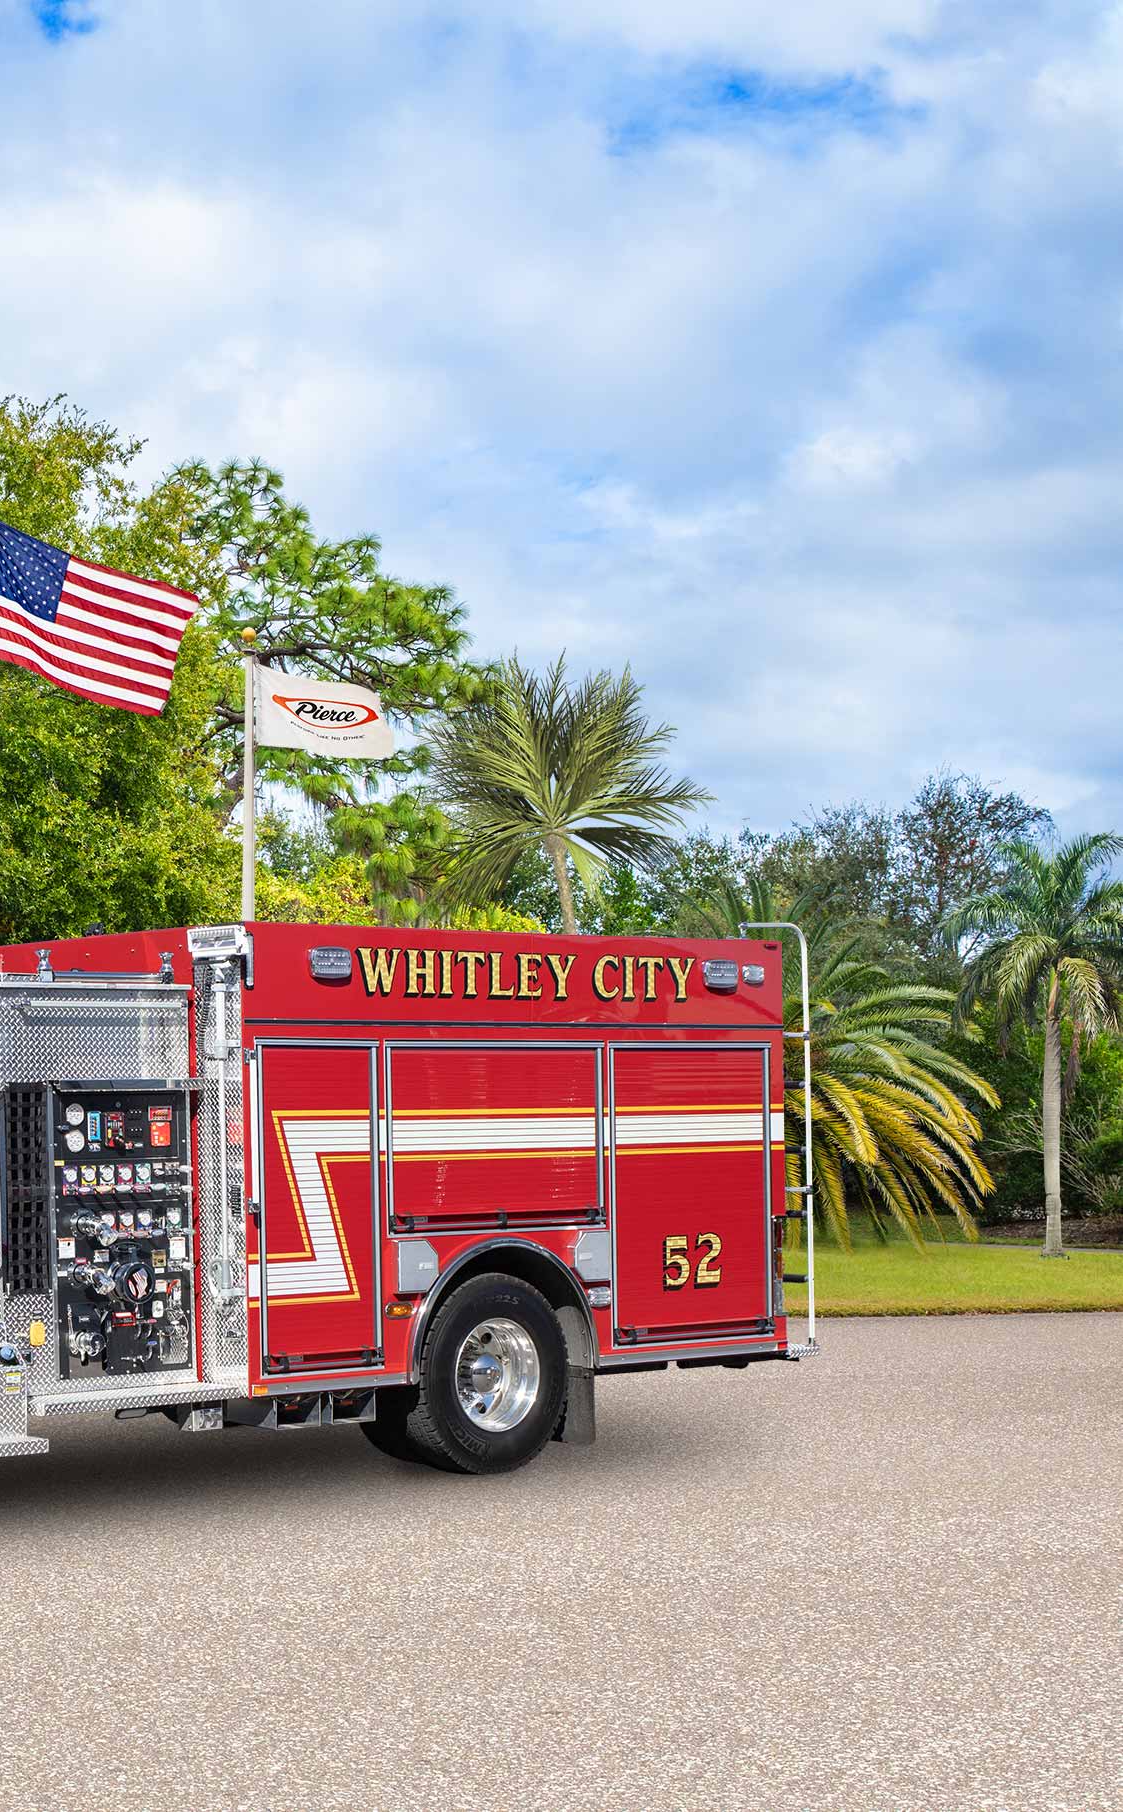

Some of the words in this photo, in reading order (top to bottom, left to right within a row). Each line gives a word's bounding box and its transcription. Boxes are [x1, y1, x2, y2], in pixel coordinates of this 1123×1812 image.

[295, 701, 357, 722] Pierce
[356, 947, 577, 1001] WHITLEY
[592, 954, 696, 1003] CITY
[663, 1232, 723, 1291] 52
